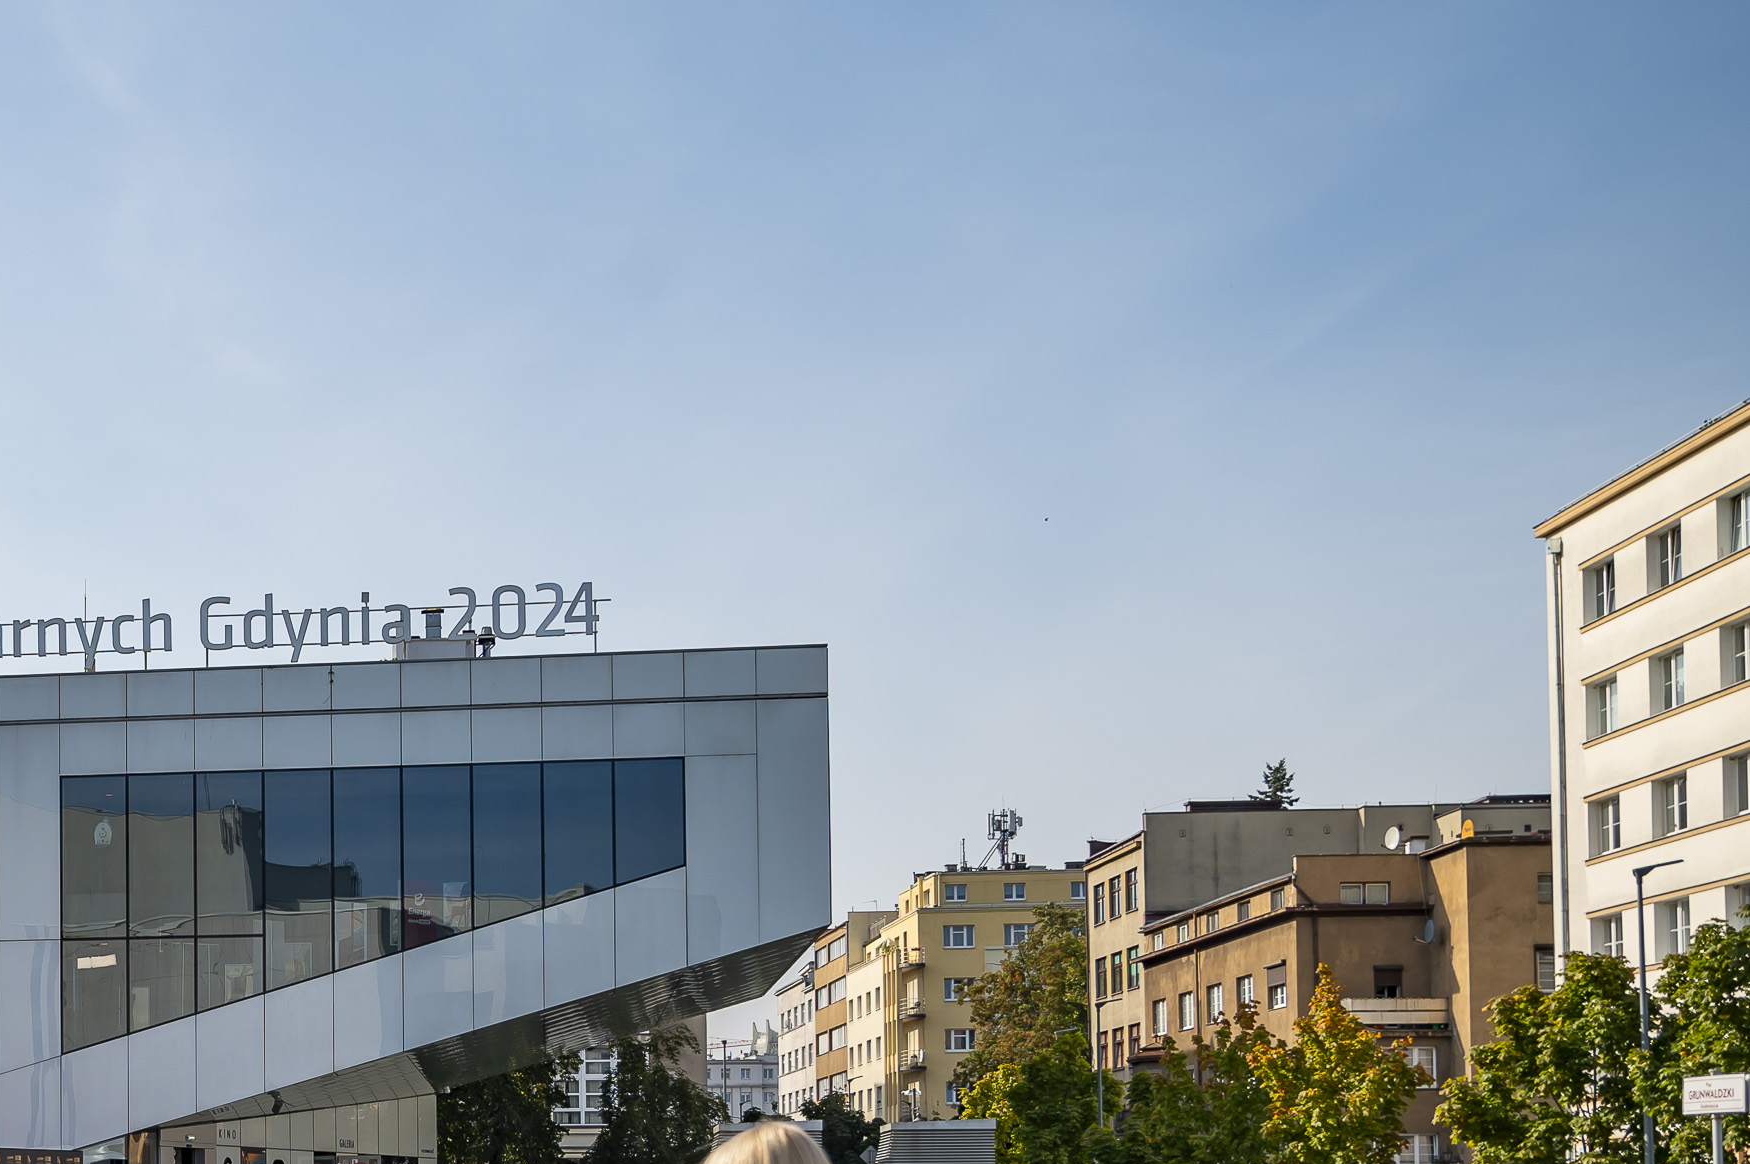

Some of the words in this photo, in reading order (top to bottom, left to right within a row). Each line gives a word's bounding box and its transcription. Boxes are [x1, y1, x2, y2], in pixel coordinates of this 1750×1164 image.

[199, 591, 412, 663] Gdynia
[447, 581, 600, 641] 2024
[407, 907, 431, 917] Energa
[1688, 1088, 1735, 1100] GRUNWALDZKI
[218, 1128, 237, 1139] KINO
